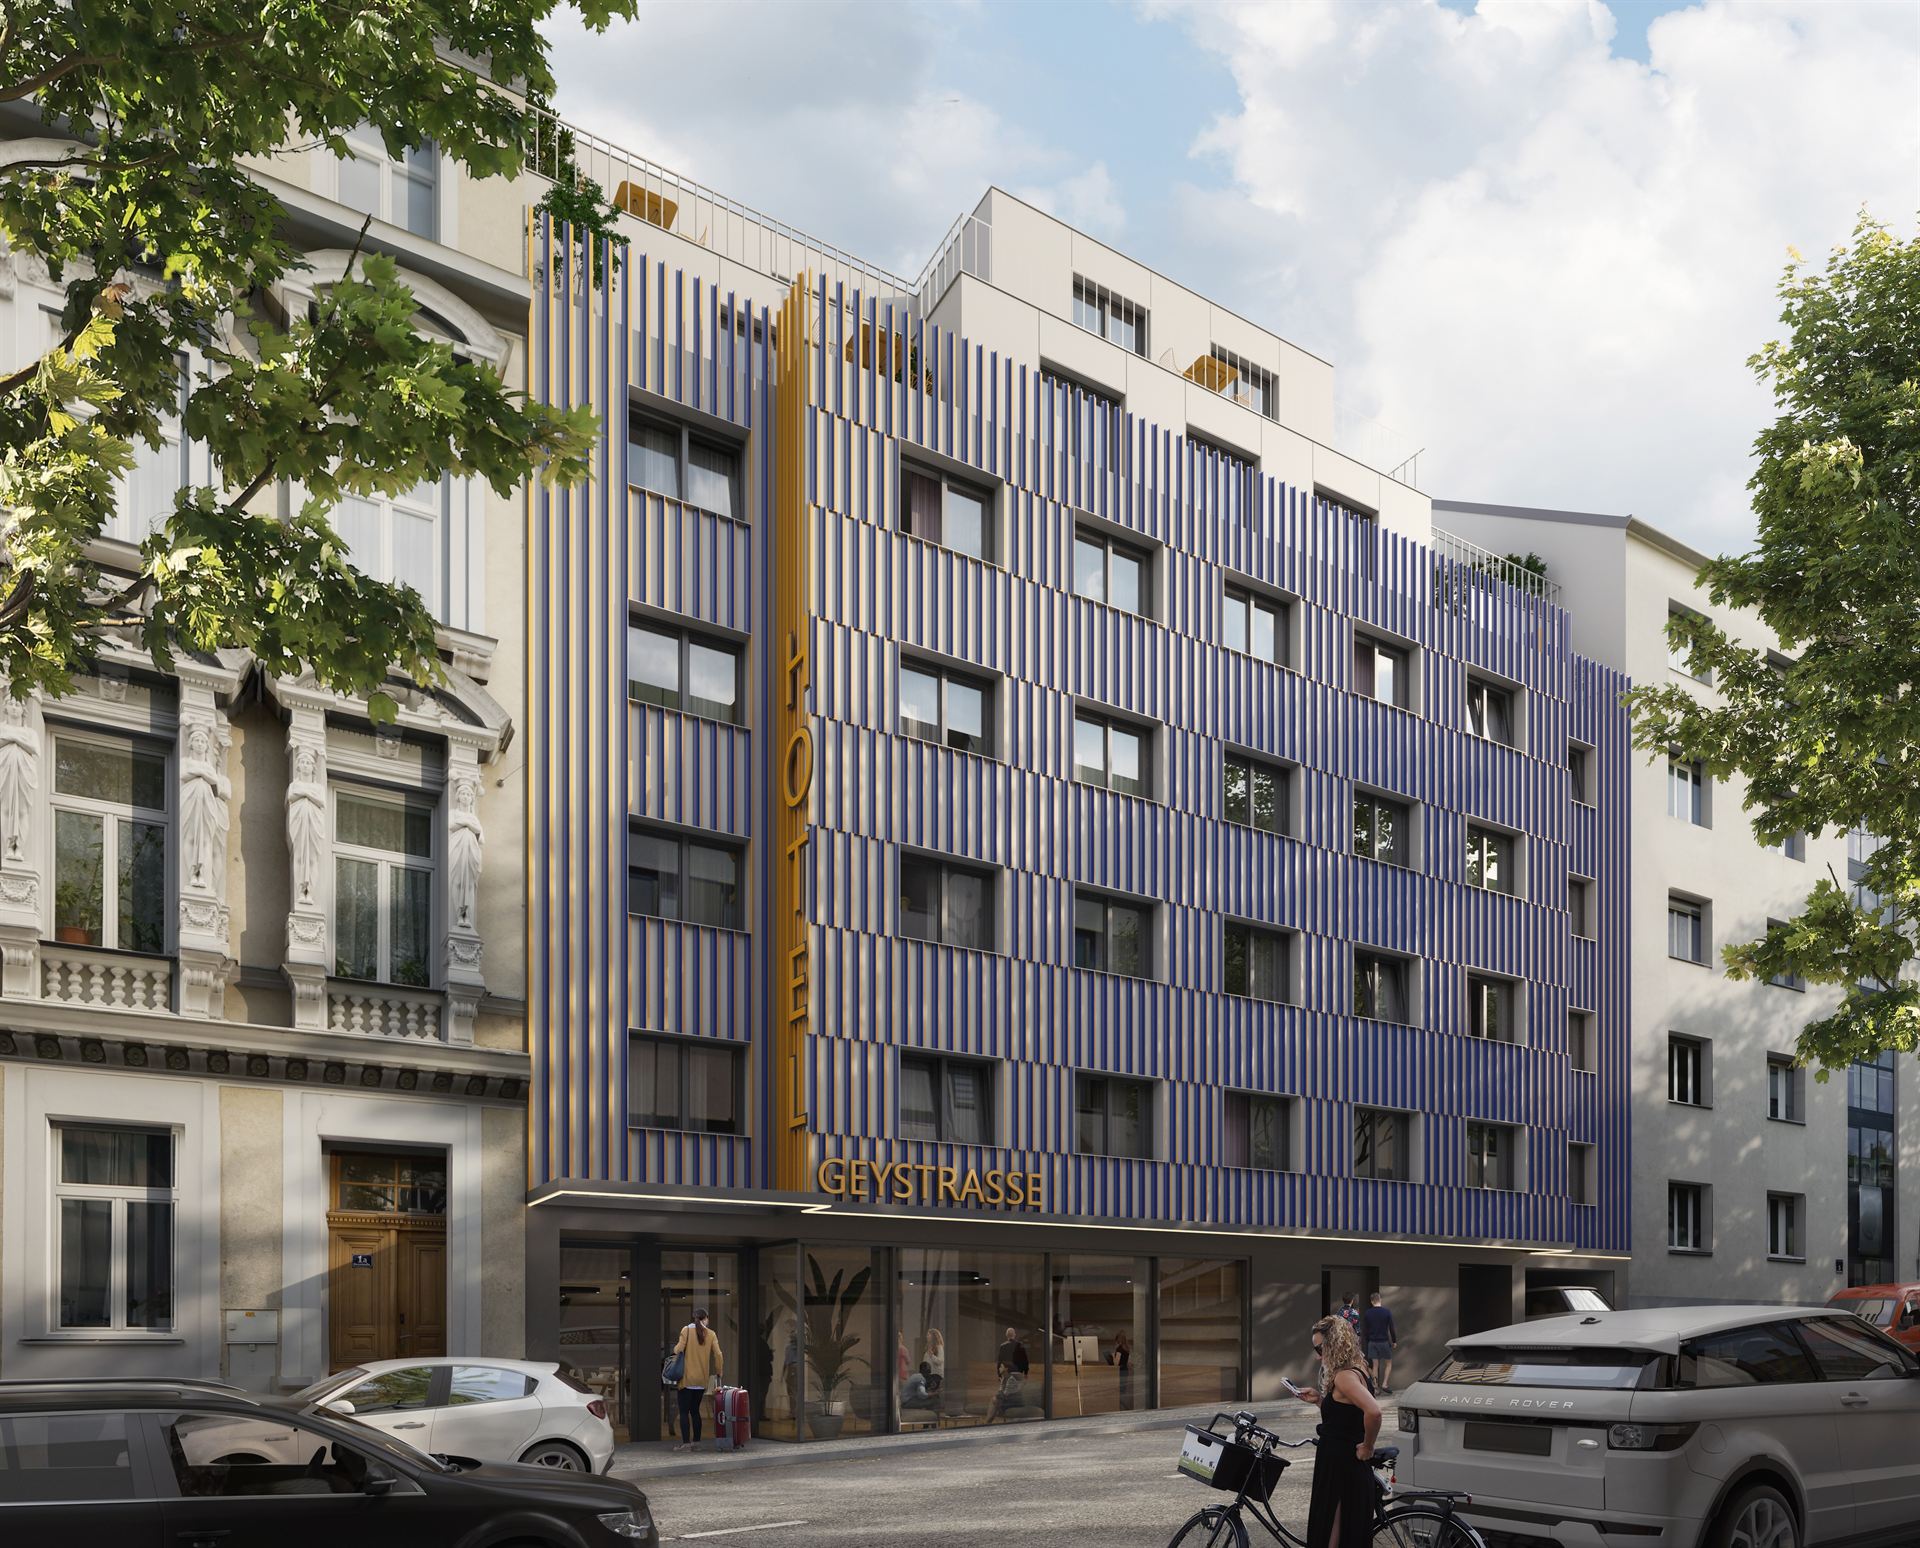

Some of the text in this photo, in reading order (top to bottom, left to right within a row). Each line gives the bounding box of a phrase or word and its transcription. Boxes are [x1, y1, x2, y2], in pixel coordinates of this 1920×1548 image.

[783, 612, 813, 1129] HOTEL
[817, 1157, 1043, 1207] GEYSTRASSE
[1439, 1395, 1574, 1409] RANGE ROVER
